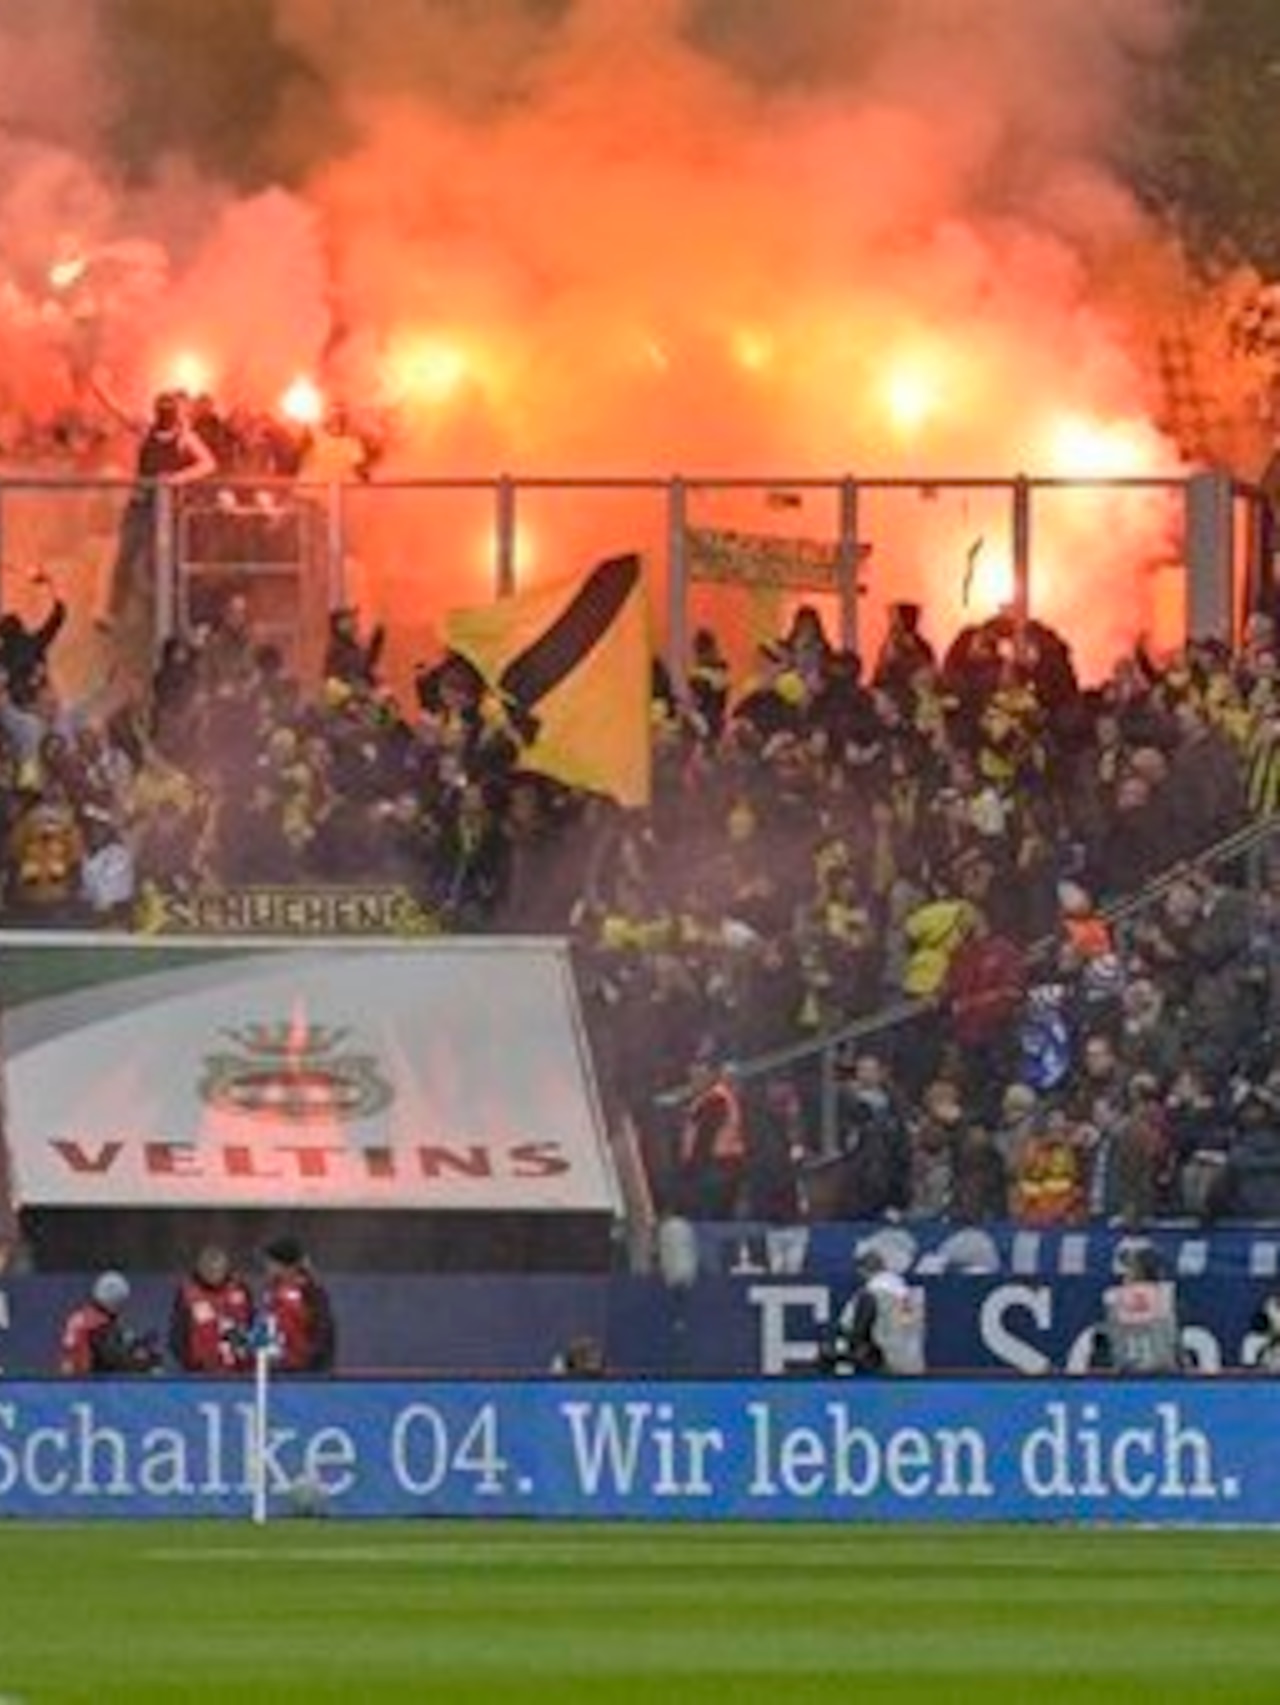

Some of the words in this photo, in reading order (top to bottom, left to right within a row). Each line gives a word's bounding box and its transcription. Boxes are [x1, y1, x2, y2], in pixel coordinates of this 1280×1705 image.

[49, 1140, 573, 1179] VELTINS
[391, 1405, 533, 1496] 04.
[563, 1402, 723, 1497] Wir
[747, 1402, 994, 1498] leben
[1021, 1402, 1241, 1498] dich.
